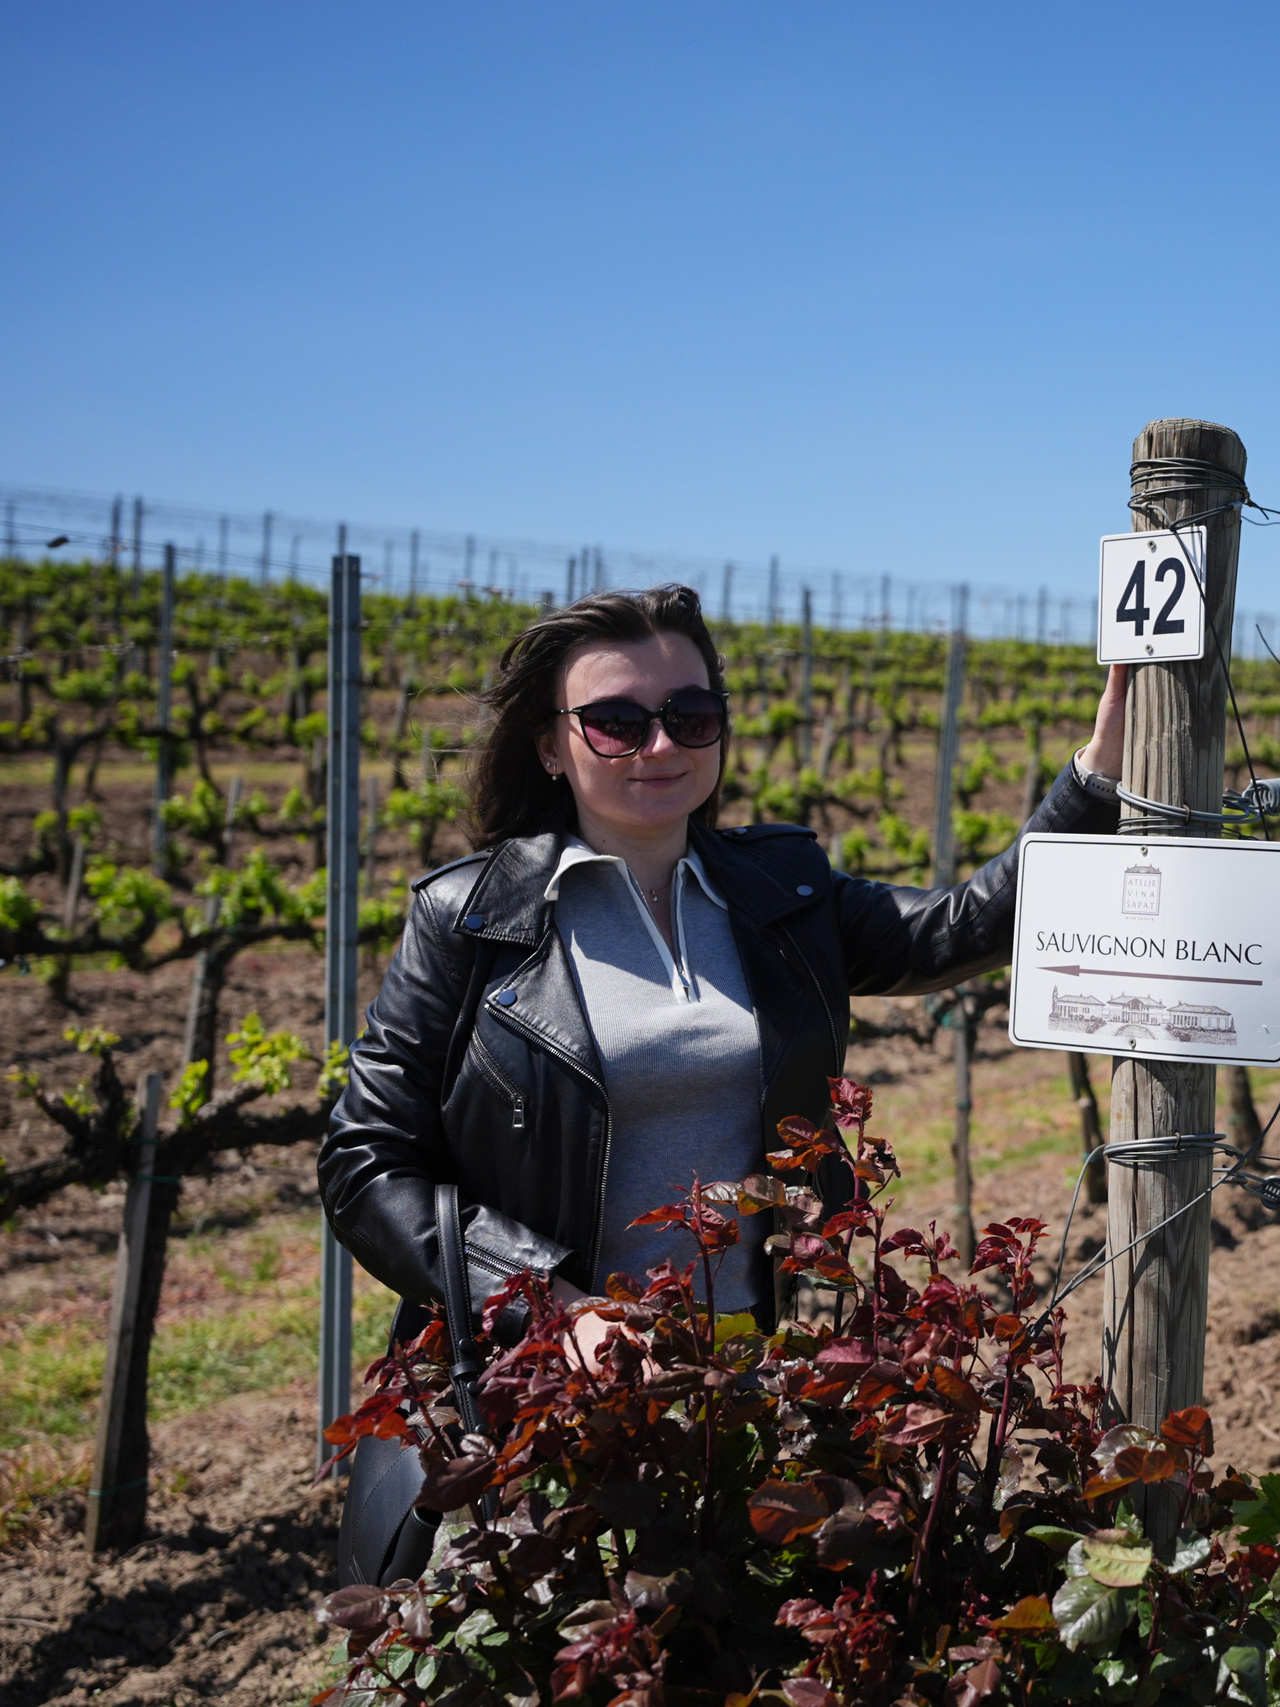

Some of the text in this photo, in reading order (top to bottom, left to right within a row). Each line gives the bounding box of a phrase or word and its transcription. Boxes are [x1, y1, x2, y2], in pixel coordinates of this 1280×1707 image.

[1116, 557, 1186, 636] 42
[1127, 879, 1156, 888] ATELJE
[1127, 889, 1155, 898] VINA
[1126, 899, 1154, 910] ŠAPAT
[1036, 931, 1263, 966] SAUVIGNON BLANC
